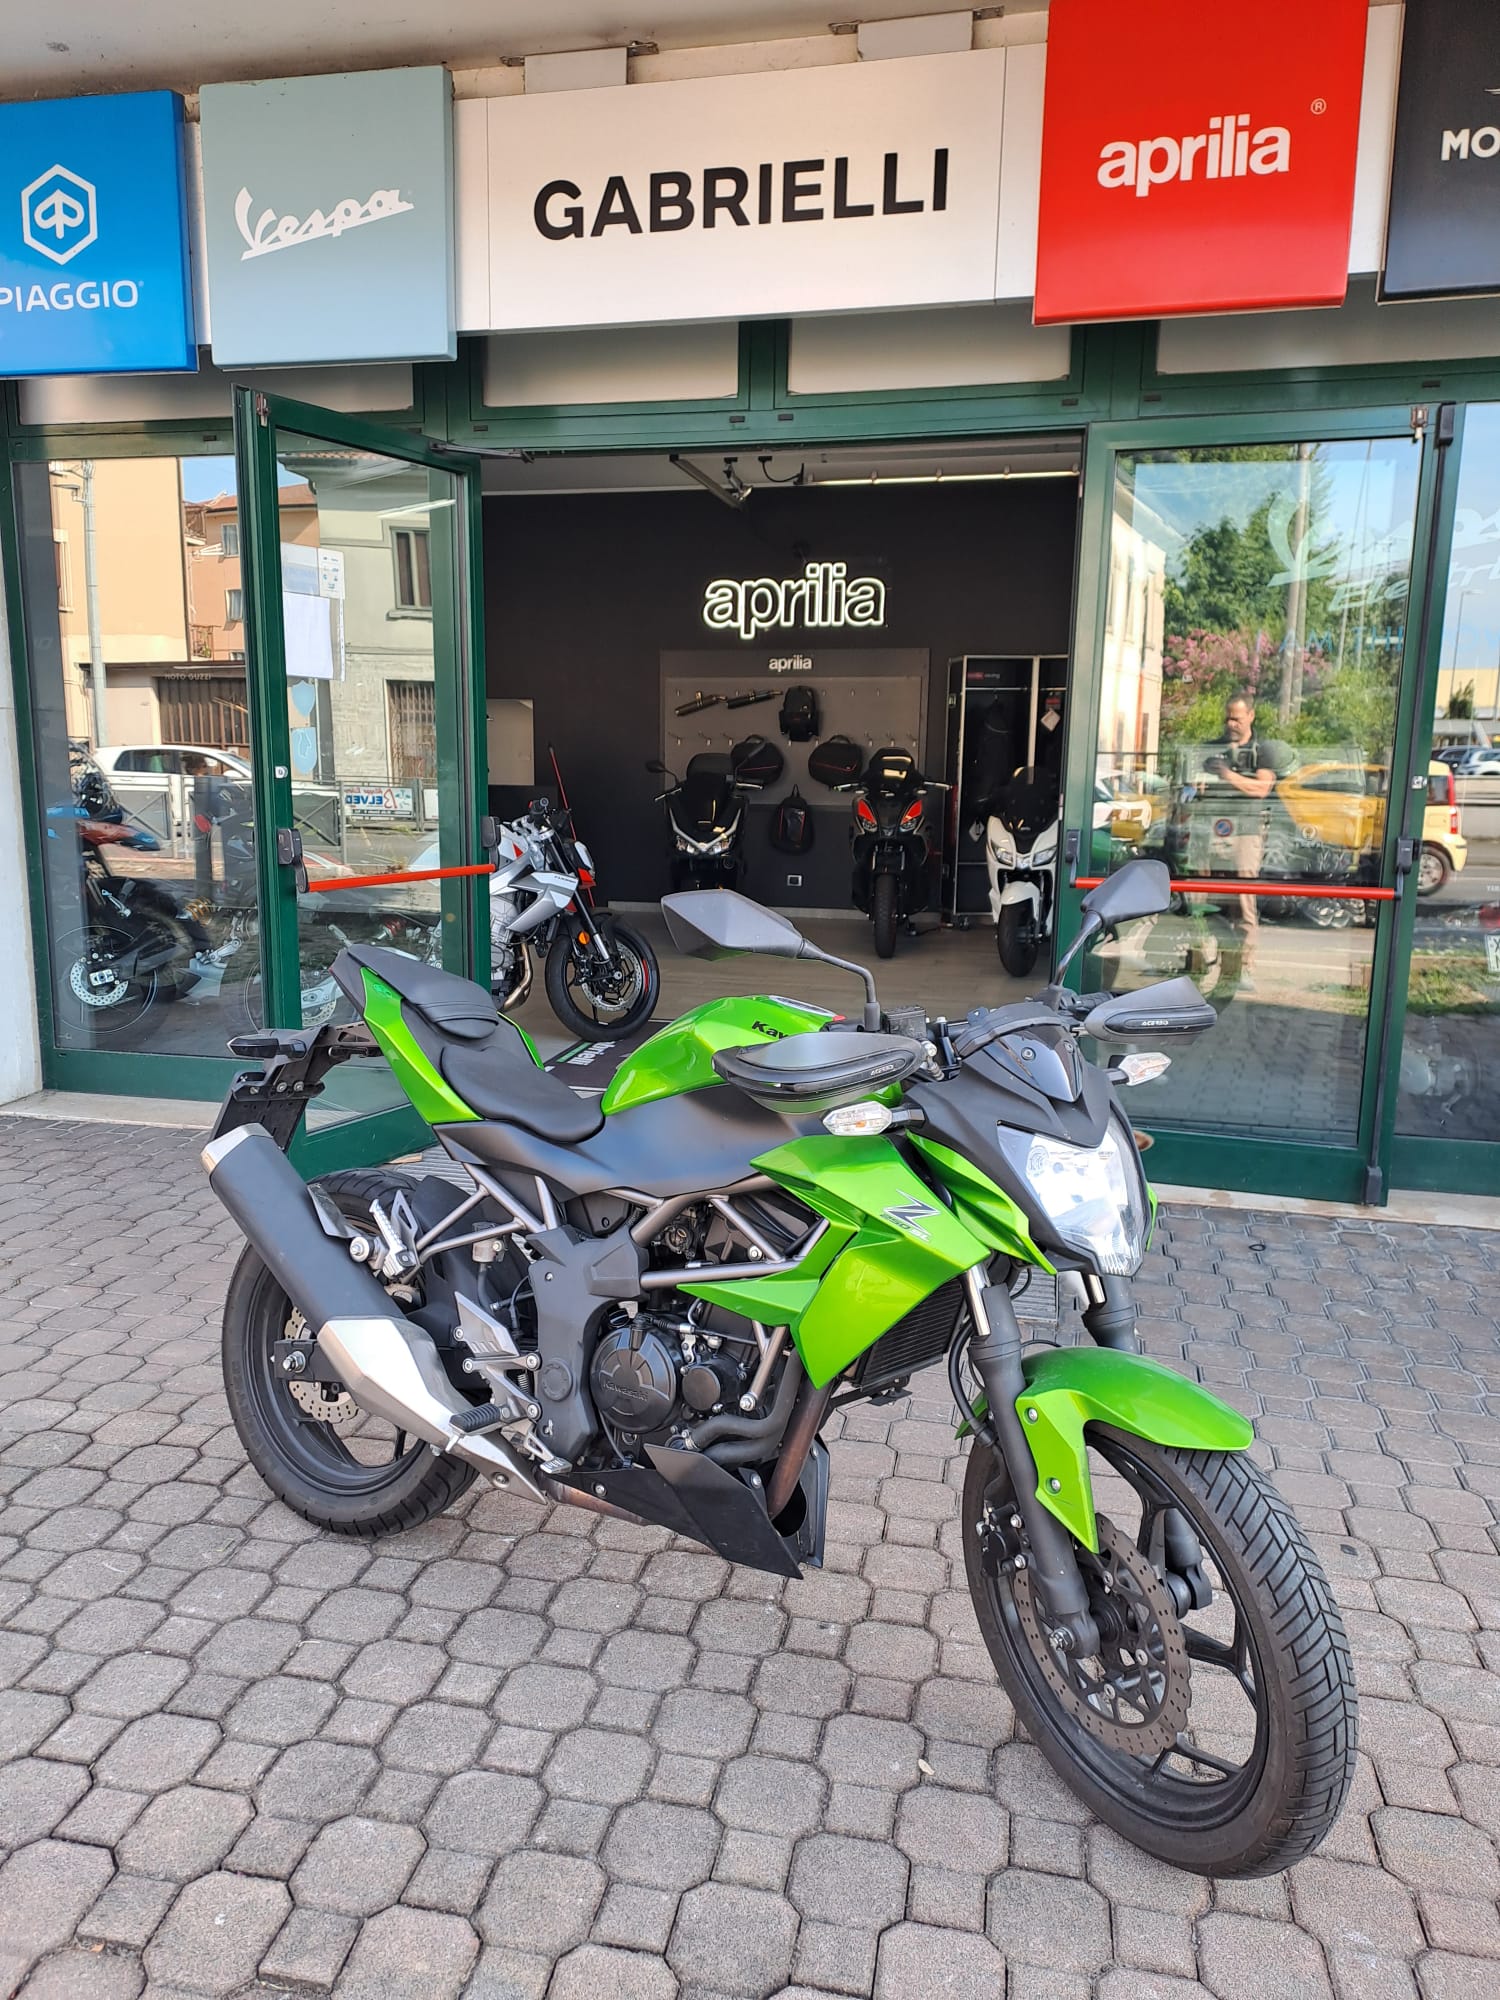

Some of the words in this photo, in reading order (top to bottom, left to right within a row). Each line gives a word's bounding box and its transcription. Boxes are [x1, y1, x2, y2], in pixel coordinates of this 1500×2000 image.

[1097, 113, 1291, 198] aprilia
[234, 186, 415, 261] Vespa
[533, 147, 949, 241] GABRIELLI
[0, 280, 139, 313] PIAGGIO
[702, 561, 886, 639] aprilia
[768, 654, 813, 673] aprilia
